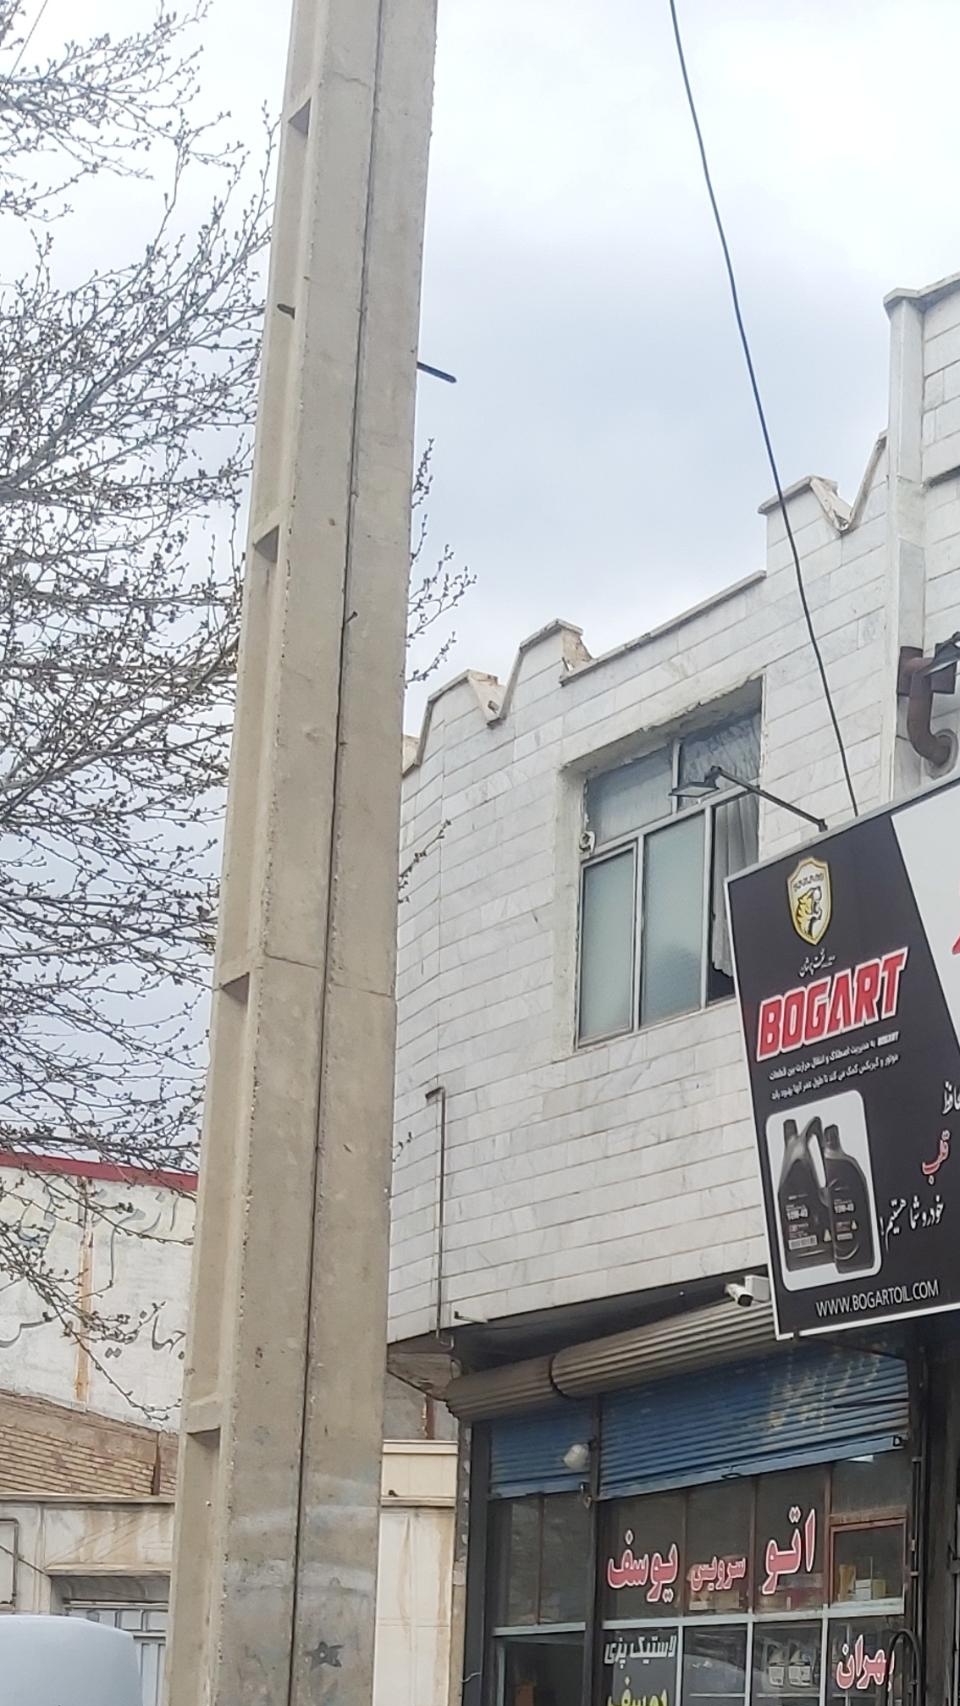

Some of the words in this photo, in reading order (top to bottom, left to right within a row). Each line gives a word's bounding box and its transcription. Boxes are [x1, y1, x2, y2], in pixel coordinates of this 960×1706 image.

[757, 946, 908, 1062] BOGART
[816, 1278, 940, 1317] WWW.BOGARTOIL.COM
[607, 1528, 679, 1603] یوسف
[690, 1555, 747, 1592] سرویس
[761, 1505, 817, 1595] اتو
[630, 1635, 677, 1664] لاستیک
